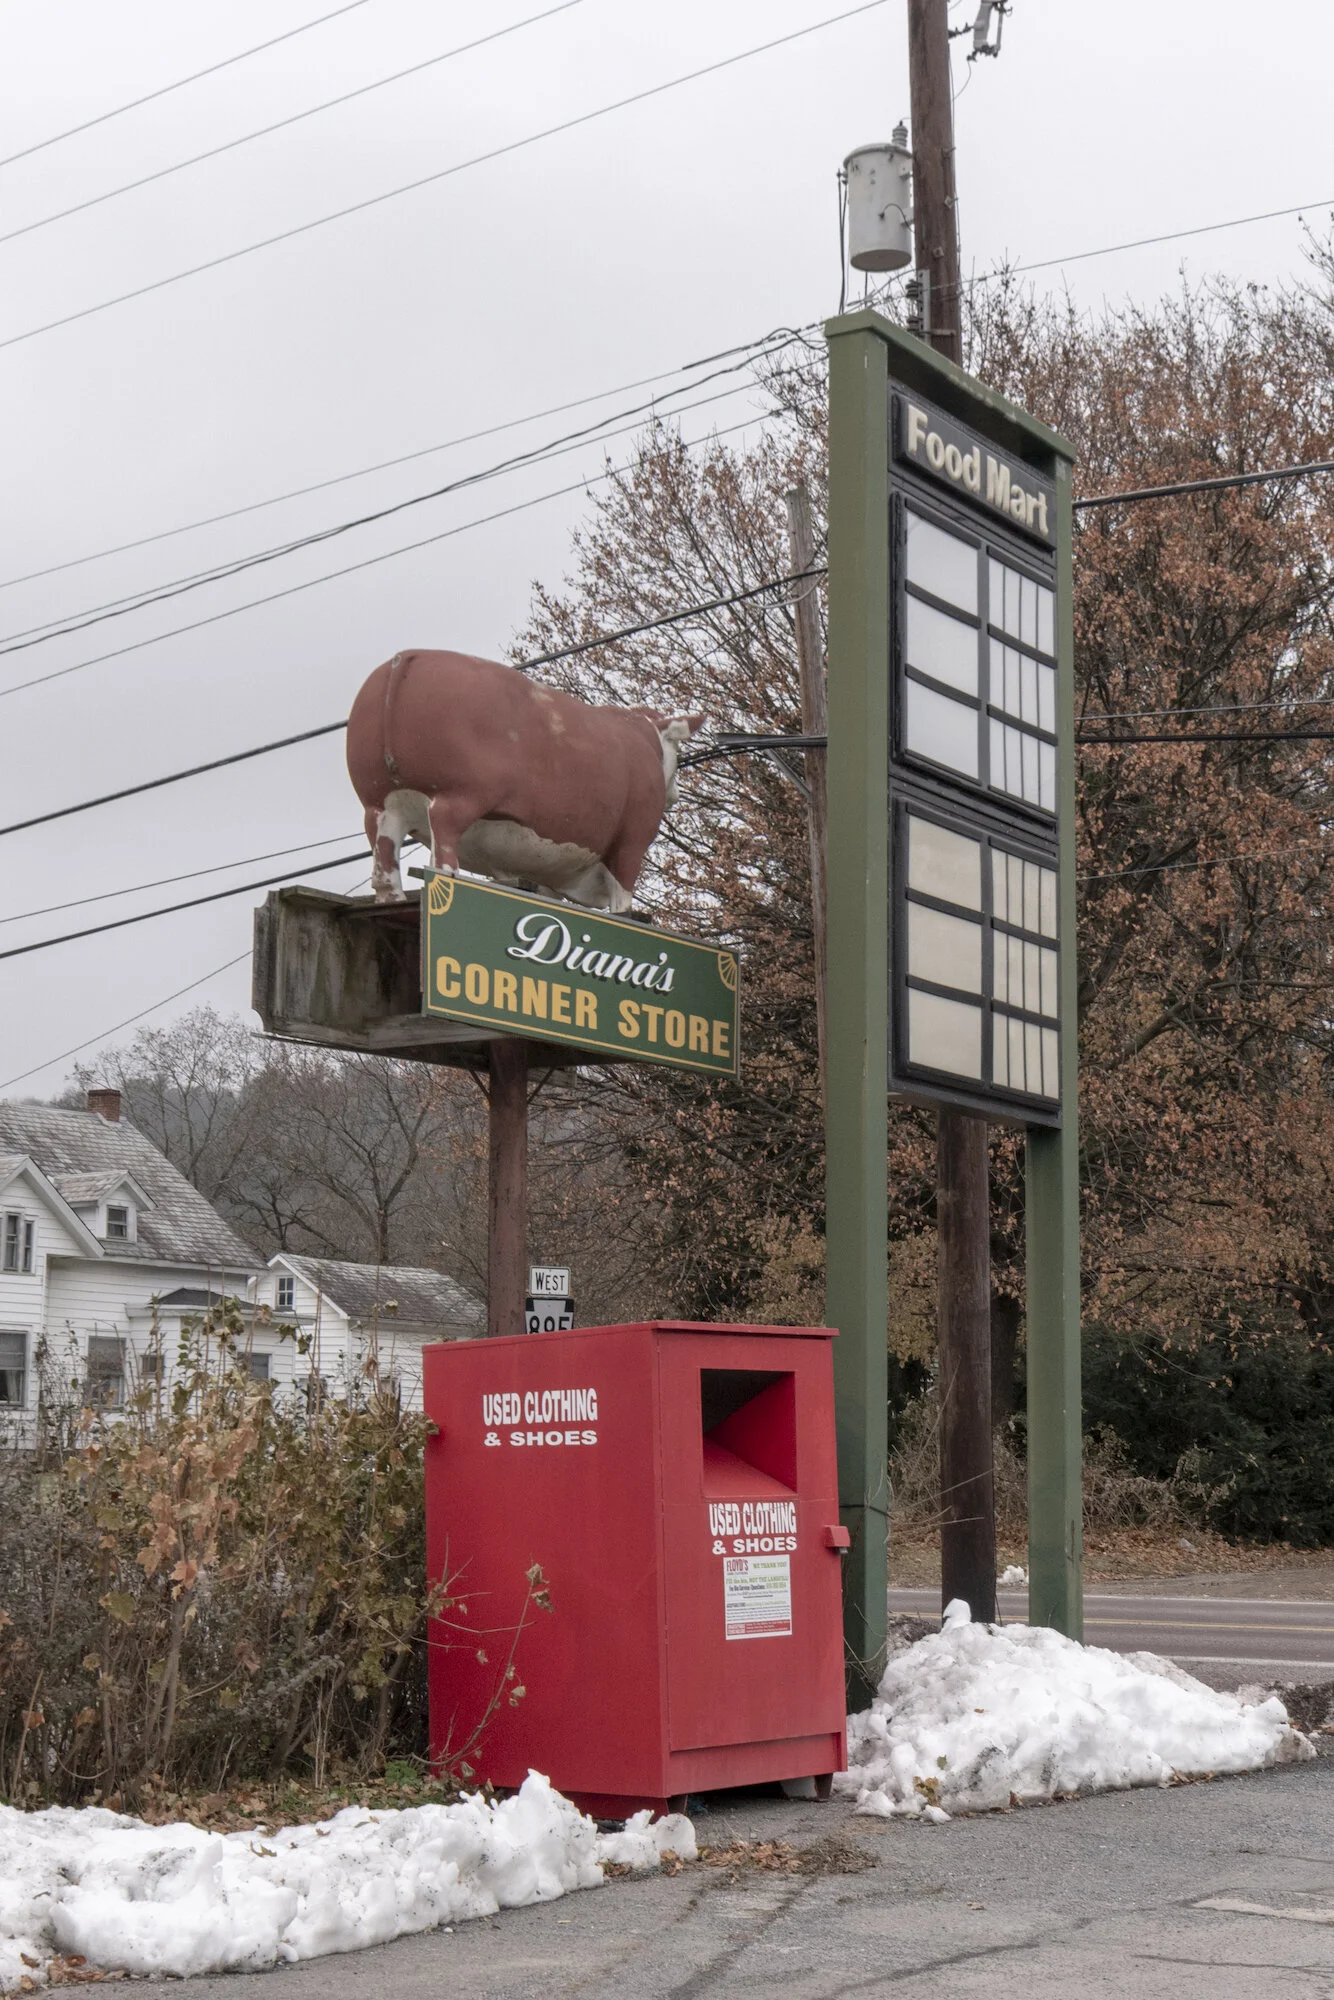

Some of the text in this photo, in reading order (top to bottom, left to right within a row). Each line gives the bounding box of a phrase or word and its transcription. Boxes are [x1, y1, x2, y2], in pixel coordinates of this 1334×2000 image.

[907, 403, 1049, 536] Food Mart
[506, 912, 676, 994] Diana's
[436, 955, 730, 1058] CORNER STORE
[535, 1271, 565, 1292] WEST
[482, 1387, 598, 1427] USED CLOTHING
[483, 1429, 598, 1447] & SHOES
[708, 1501, 797, 1537] USED CLOTHING
[712, 1536, 798, 1555] & SHOES
[726, 1558, 749, 1572] FLOYD'S
